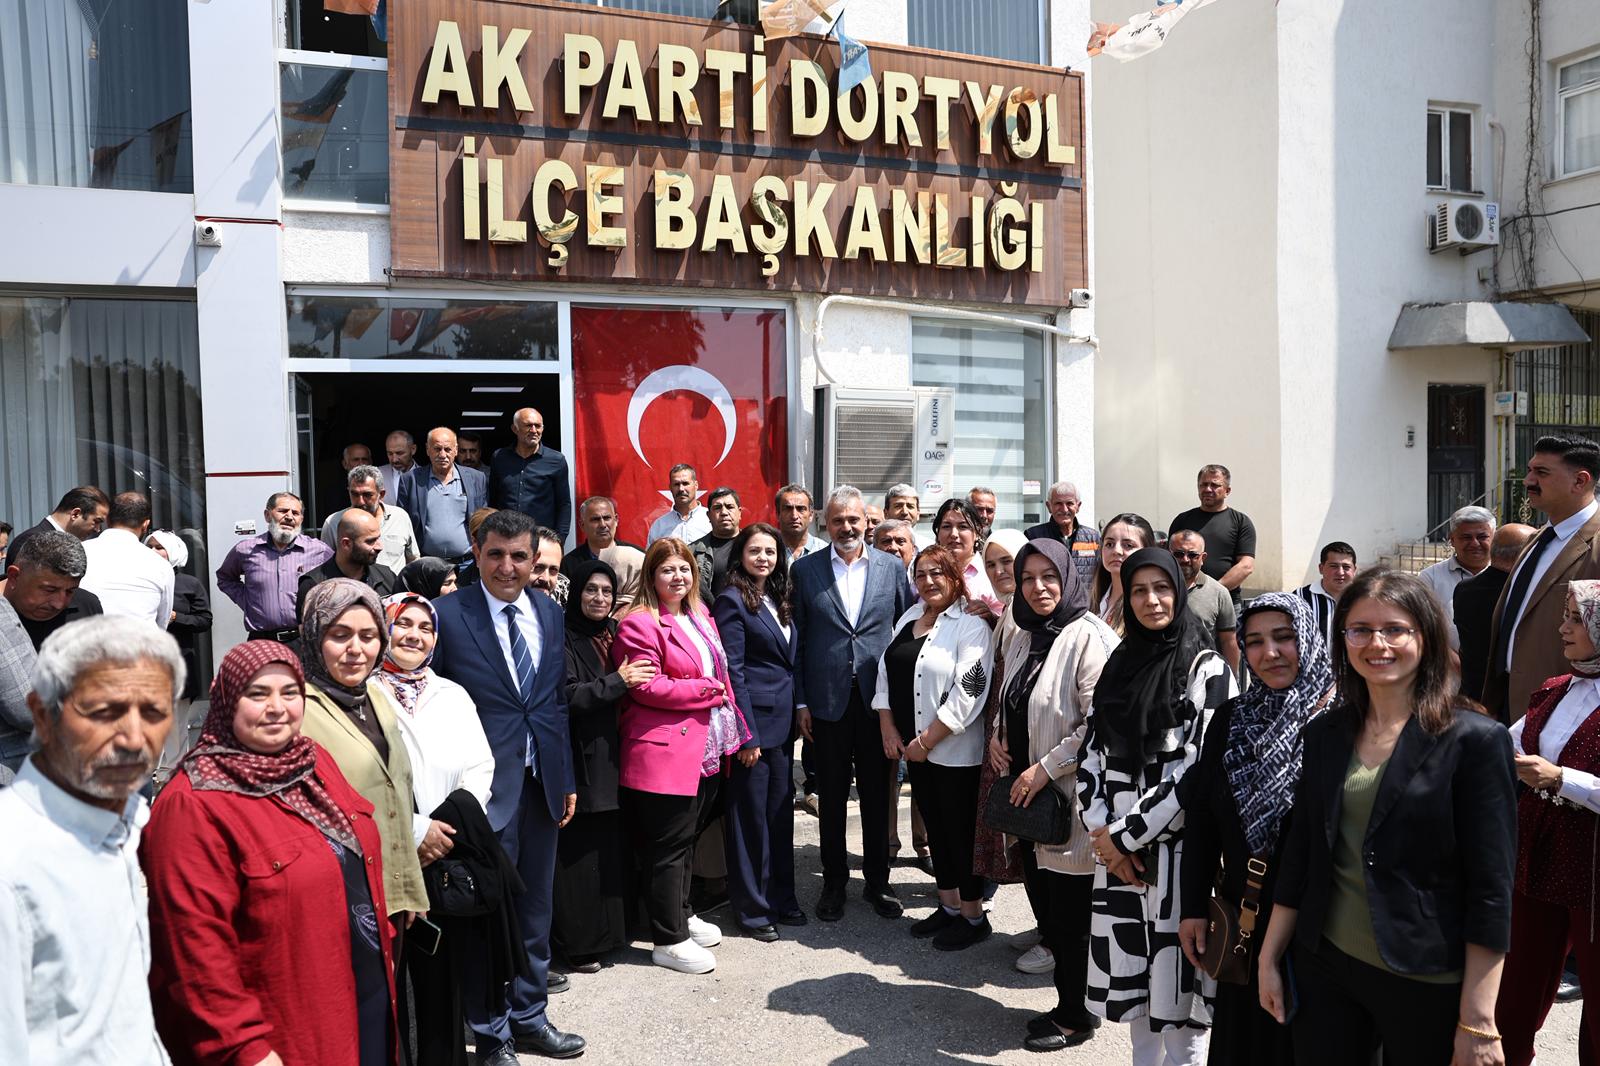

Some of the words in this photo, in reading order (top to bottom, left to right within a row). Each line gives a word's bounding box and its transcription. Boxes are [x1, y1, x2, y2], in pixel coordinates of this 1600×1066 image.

[421, 20, 534, 112] AK
[564, 33, 767, 132] PARTİ
[463, 136, 627, 267] İLÇE
[654, 170, 1044, 276] BAŞKANLIĞI
